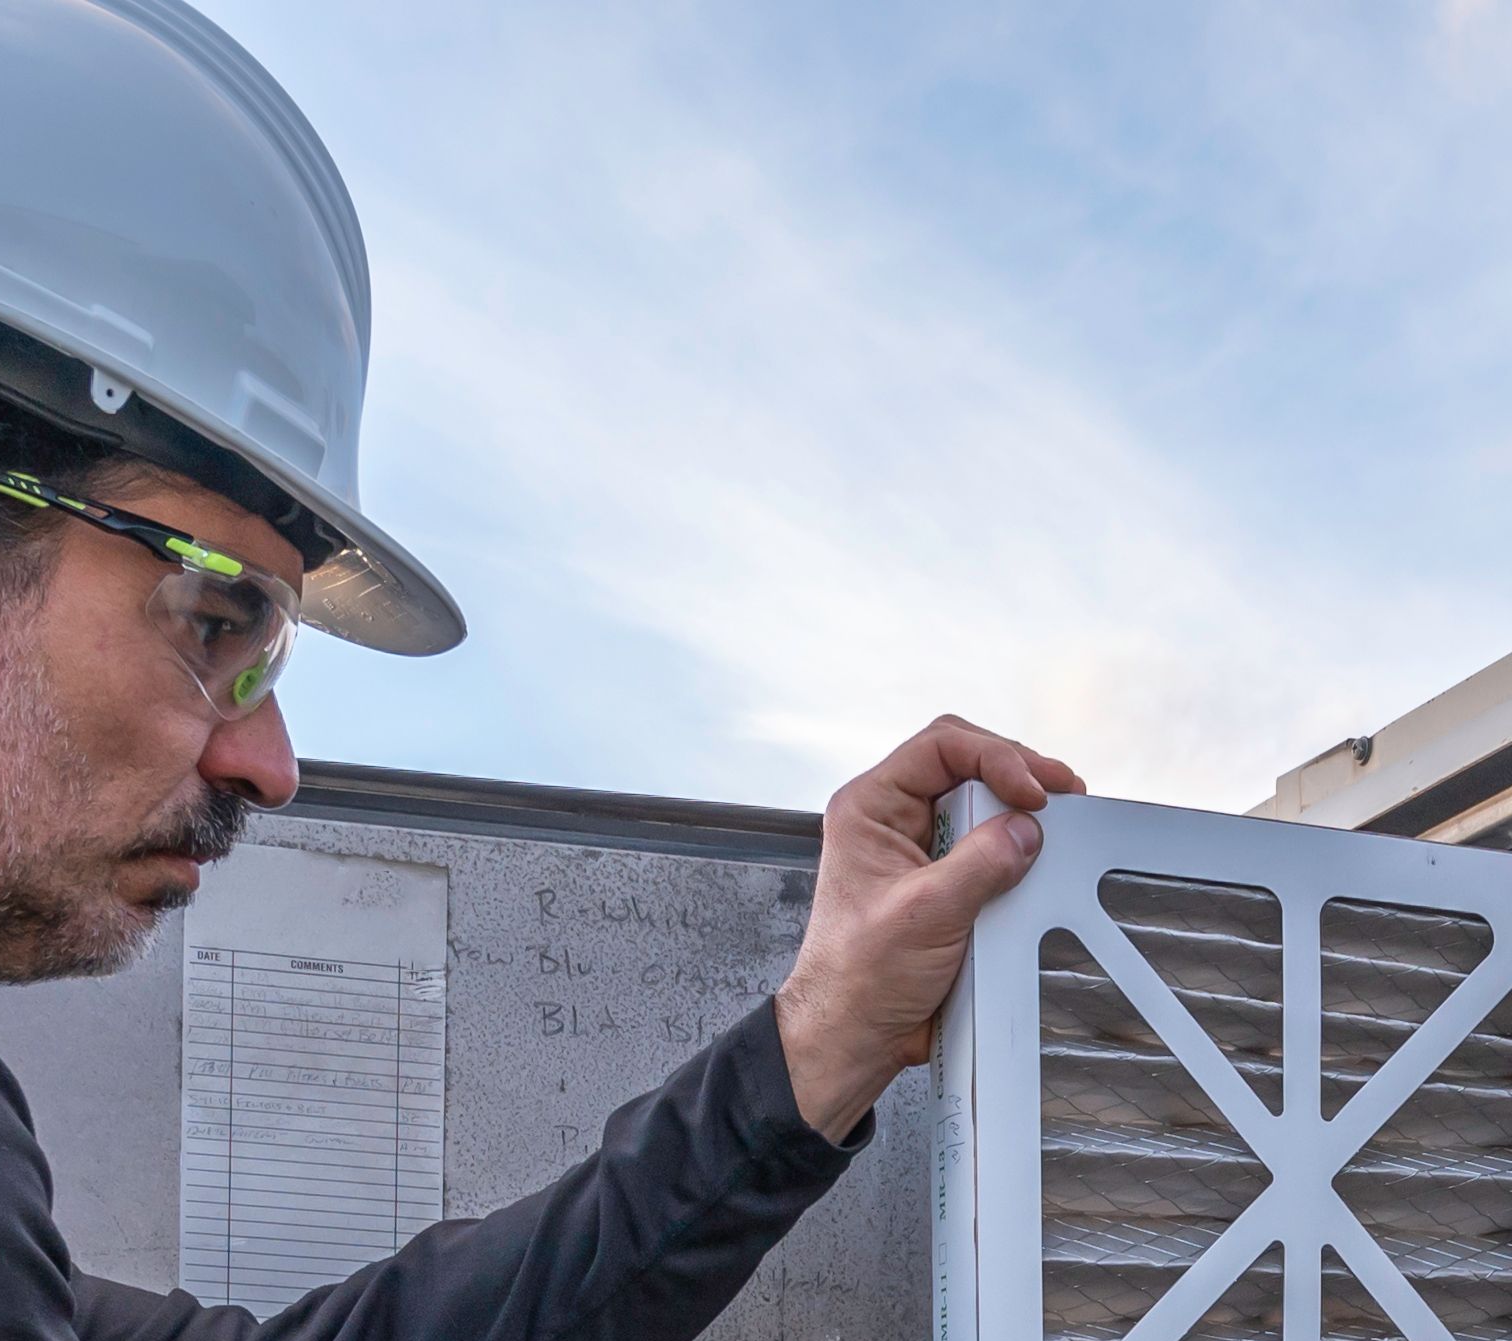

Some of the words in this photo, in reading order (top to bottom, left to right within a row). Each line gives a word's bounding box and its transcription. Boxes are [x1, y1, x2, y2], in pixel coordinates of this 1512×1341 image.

[197, 951, 220, 962] DATE
[290, 960, 344, 974] COMMENTS
[937, 1150, 946, 1221] MR-13
[941, 1274, 949, 1341] MR-11
